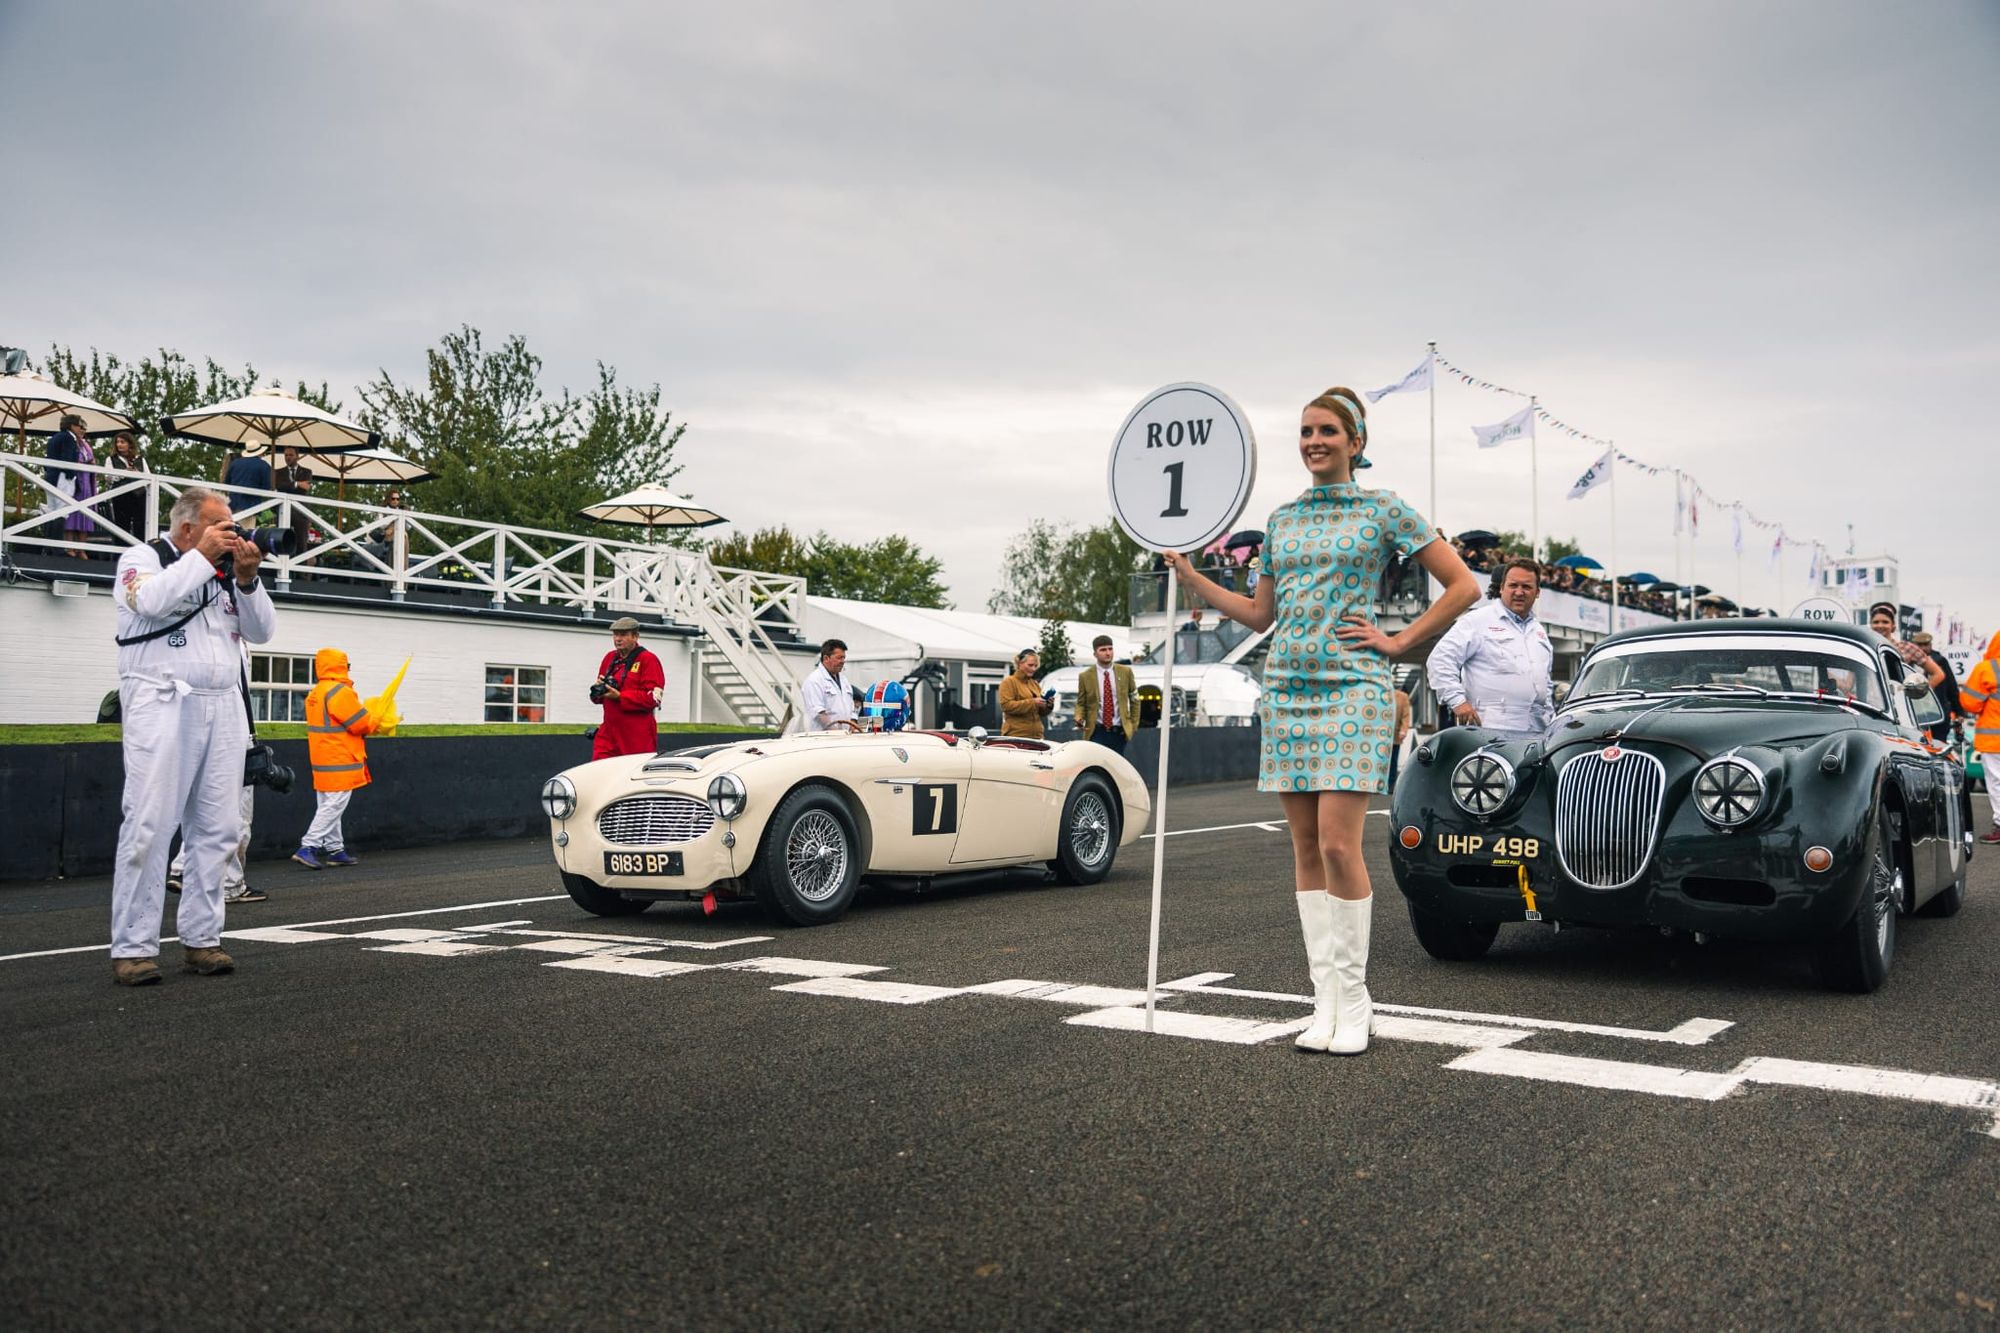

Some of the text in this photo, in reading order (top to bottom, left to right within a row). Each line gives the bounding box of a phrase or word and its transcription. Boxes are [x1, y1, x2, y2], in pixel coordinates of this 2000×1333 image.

[1146, 418, 1213, 449] ROW
[1160, 461, 1189, 518] 1
[1804, 609, 1836, 620] ROW
[170, 636, 185, 646] 66
[1955, 662, 1965, 676] 3
[929, 788, 944, 831] 7
[1438, 834, 1539, 858] UHP 498
[611, 854, 669, 873] 6183 BP
